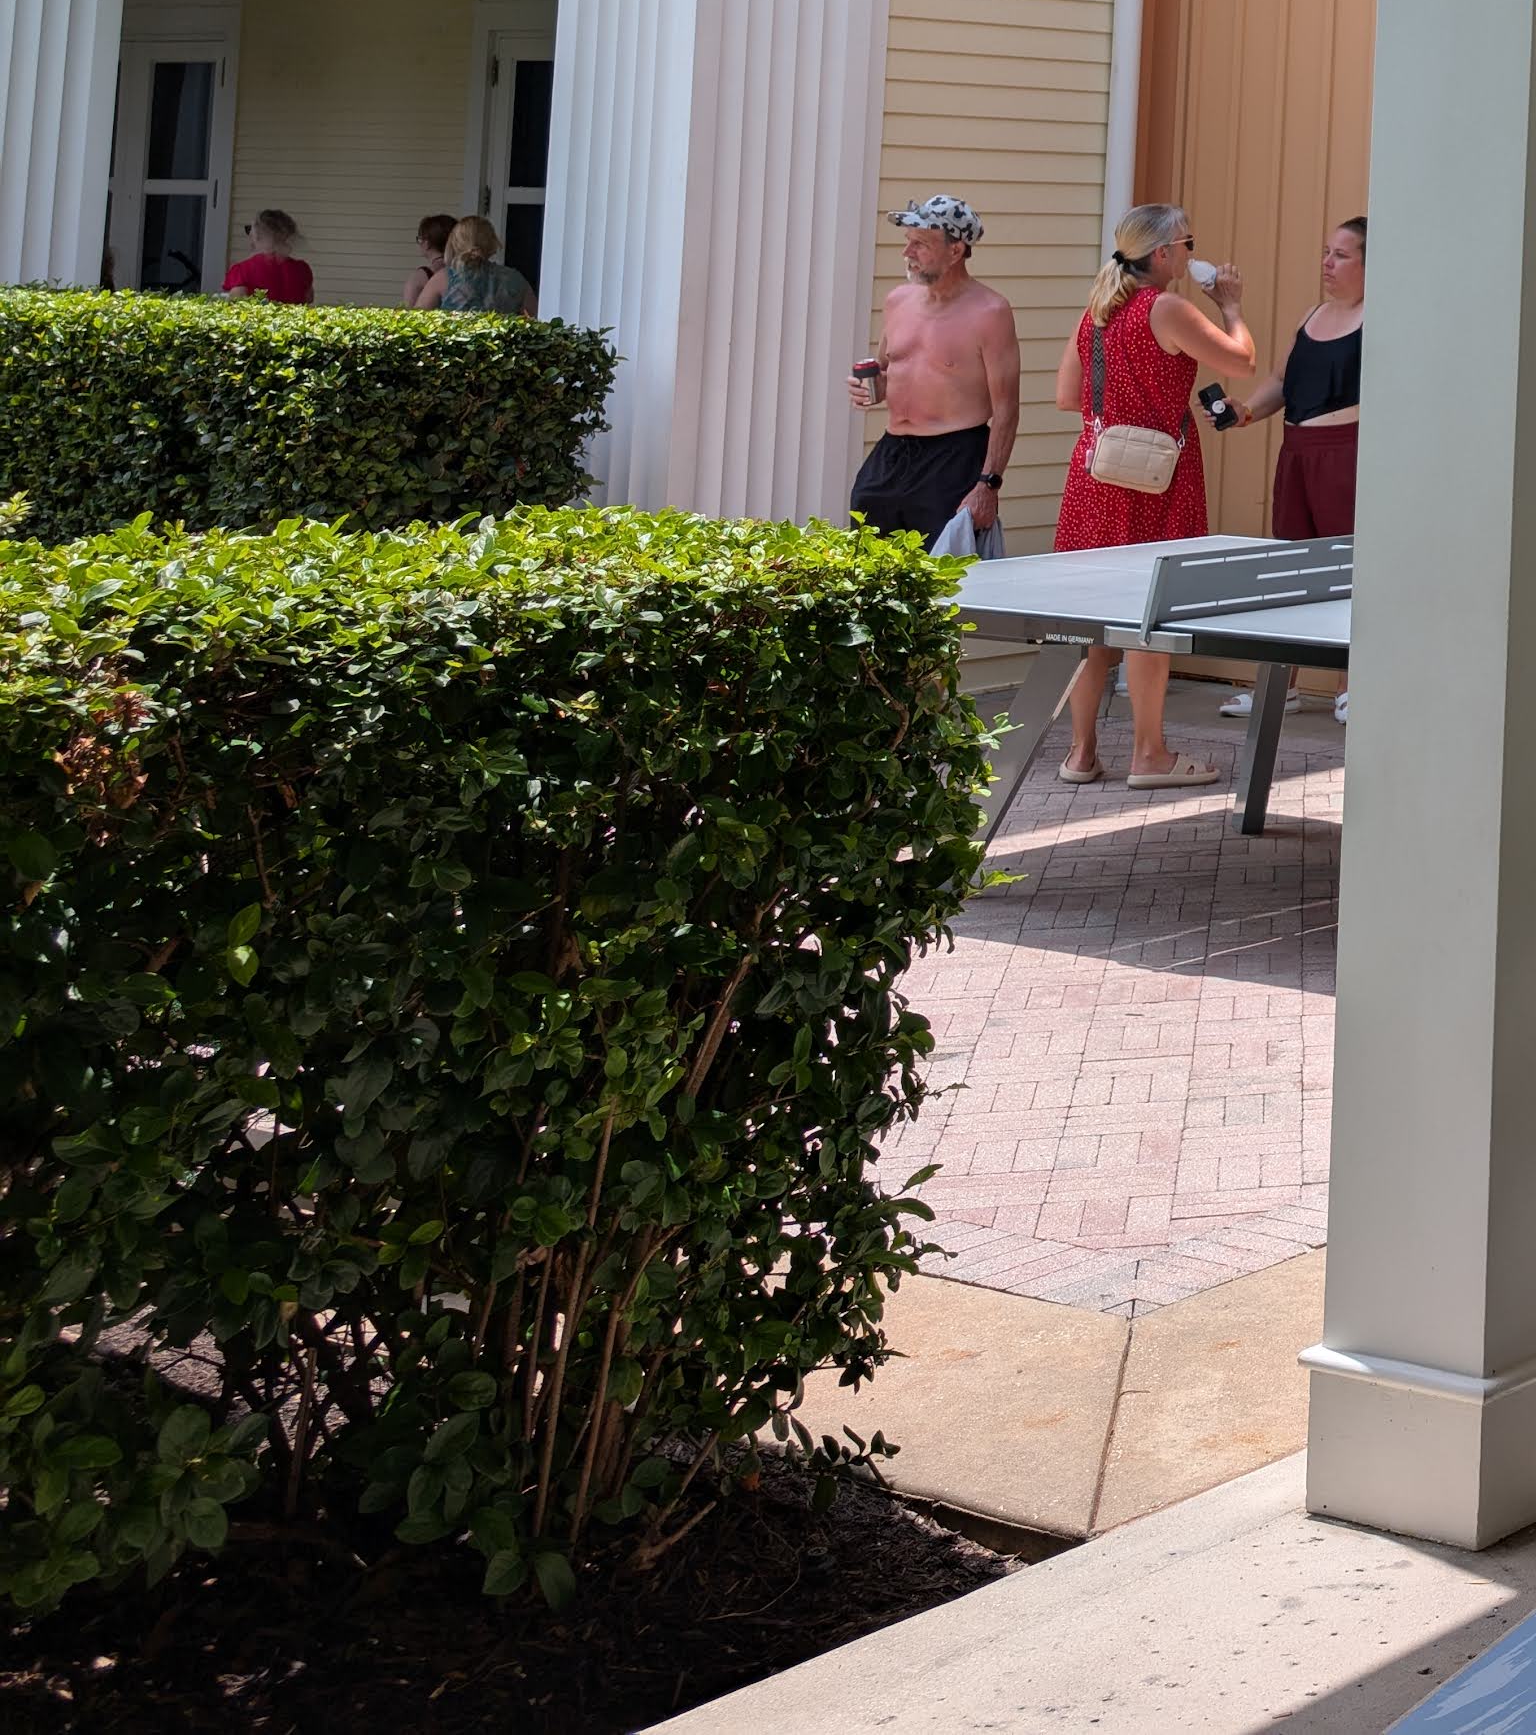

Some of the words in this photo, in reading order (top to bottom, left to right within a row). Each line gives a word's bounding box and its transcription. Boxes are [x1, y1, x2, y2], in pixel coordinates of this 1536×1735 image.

[1046, 633, 1060, 641] MADE
[1062, 634, 1067, 642] IN
[1068, 635, 1094, 644] GERMANY
